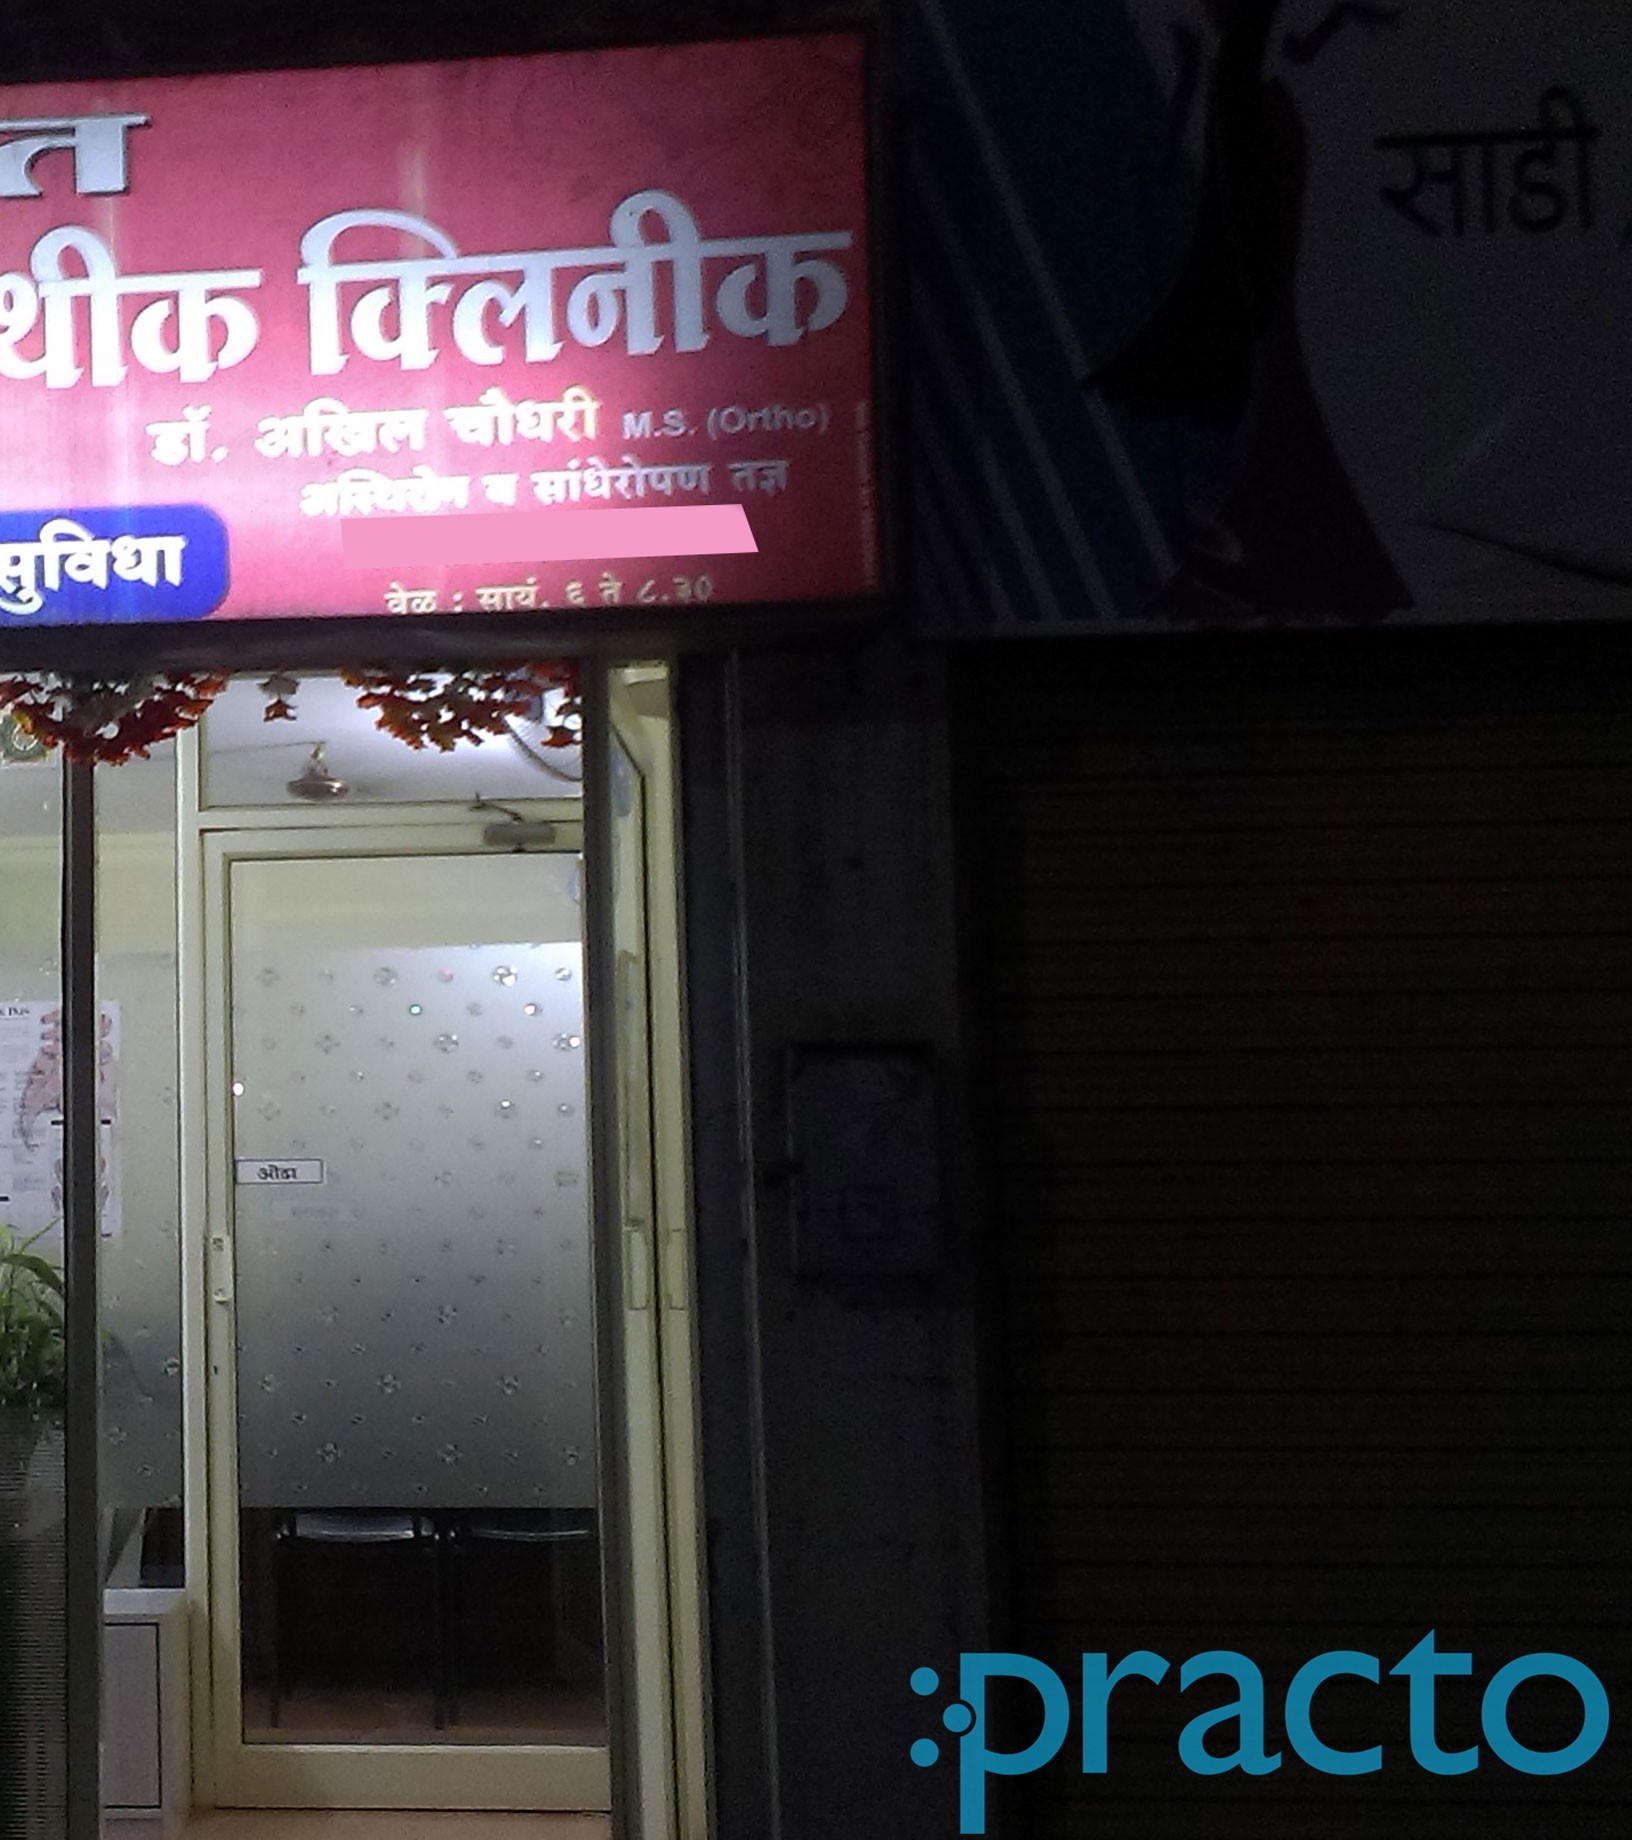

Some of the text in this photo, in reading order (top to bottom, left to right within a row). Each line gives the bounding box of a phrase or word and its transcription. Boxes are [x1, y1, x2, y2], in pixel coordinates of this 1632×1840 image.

[1375, 86, 1600, 237] साडी
[298, 188, 854, 374] क्लिनीक
[145, 385, 832, 467] डॉ. अखिल चौधरी M.S. (Ortho)
[727, 458, 791, 496] तज्ञ
[384, 581, 437, 616] वेळ
[565, 580, 585, 606] ६
[599, 572, 624, 605] ते
